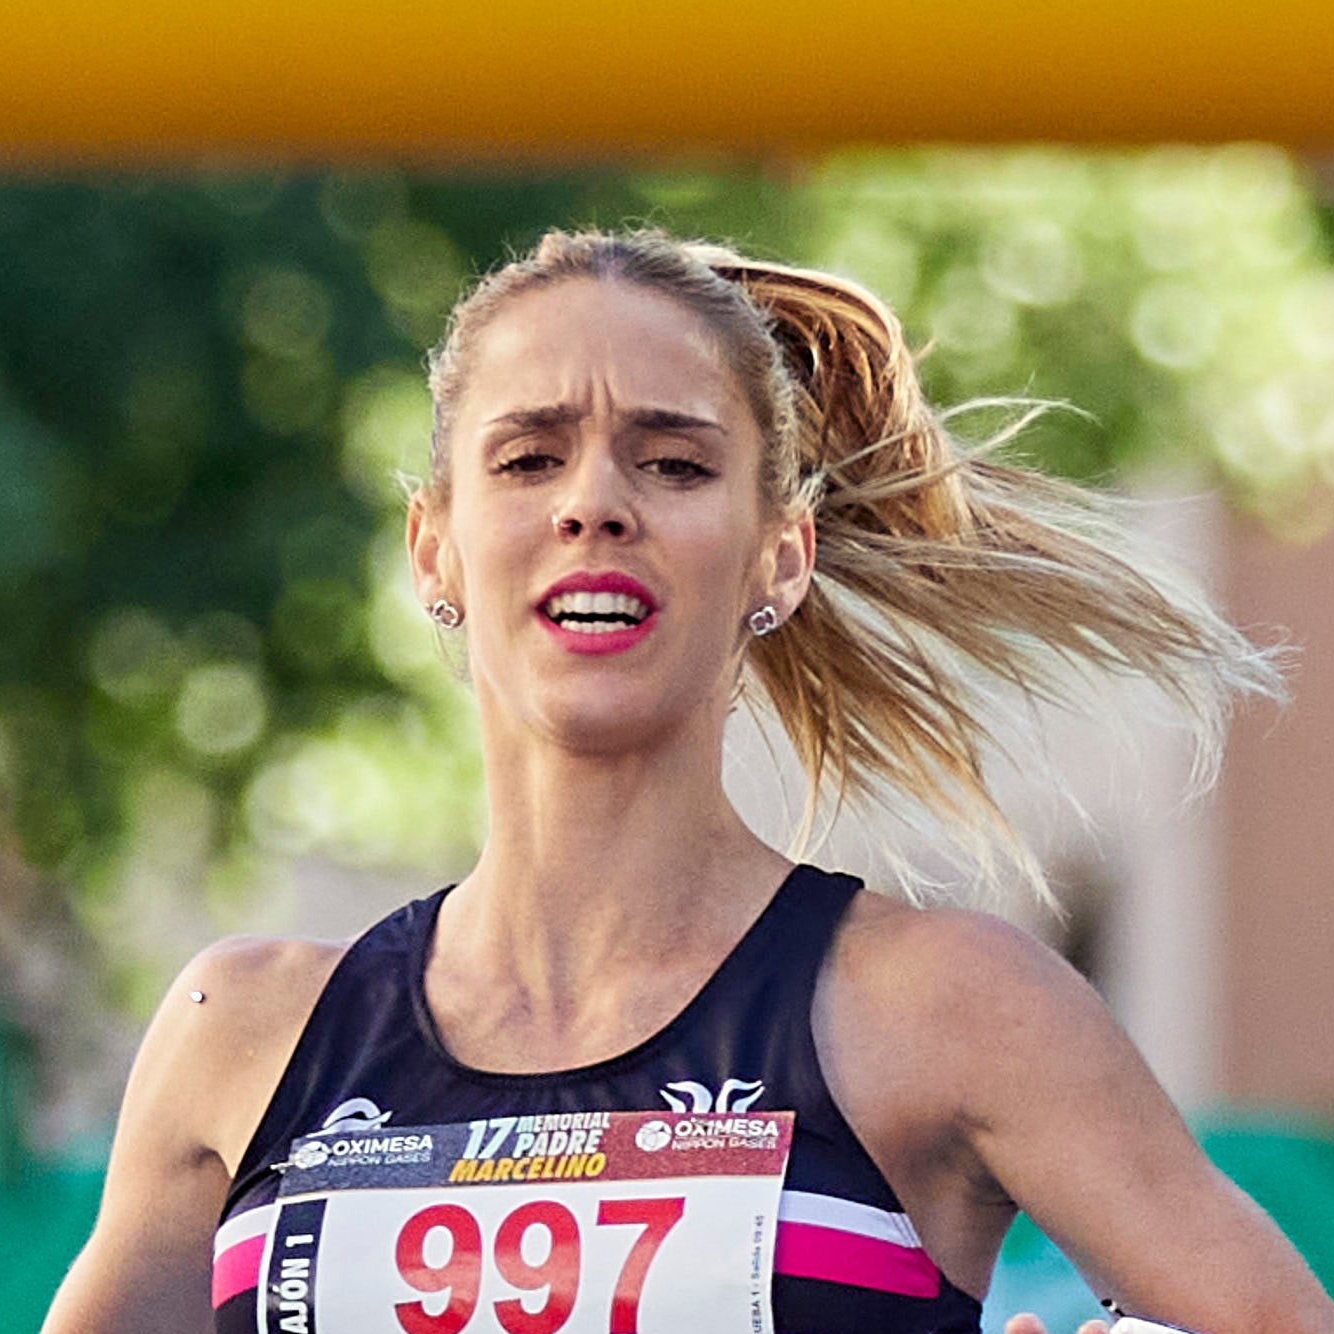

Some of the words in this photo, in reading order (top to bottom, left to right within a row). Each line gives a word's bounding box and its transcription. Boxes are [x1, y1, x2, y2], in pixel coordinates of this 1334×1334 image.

[462, 1117, 517, 1159] 17
[517, 1112, 611, 1133] MEMORIAL
[674, 1118, 779, 1137] OXIMESA
[333, 1135, 433, 1156] OXIMESA
[512, 1129, 603, 1158] PADRE
[449, 1152, 606, 1182] MARCELINO
[286, 1234, 314, 1248] 1
